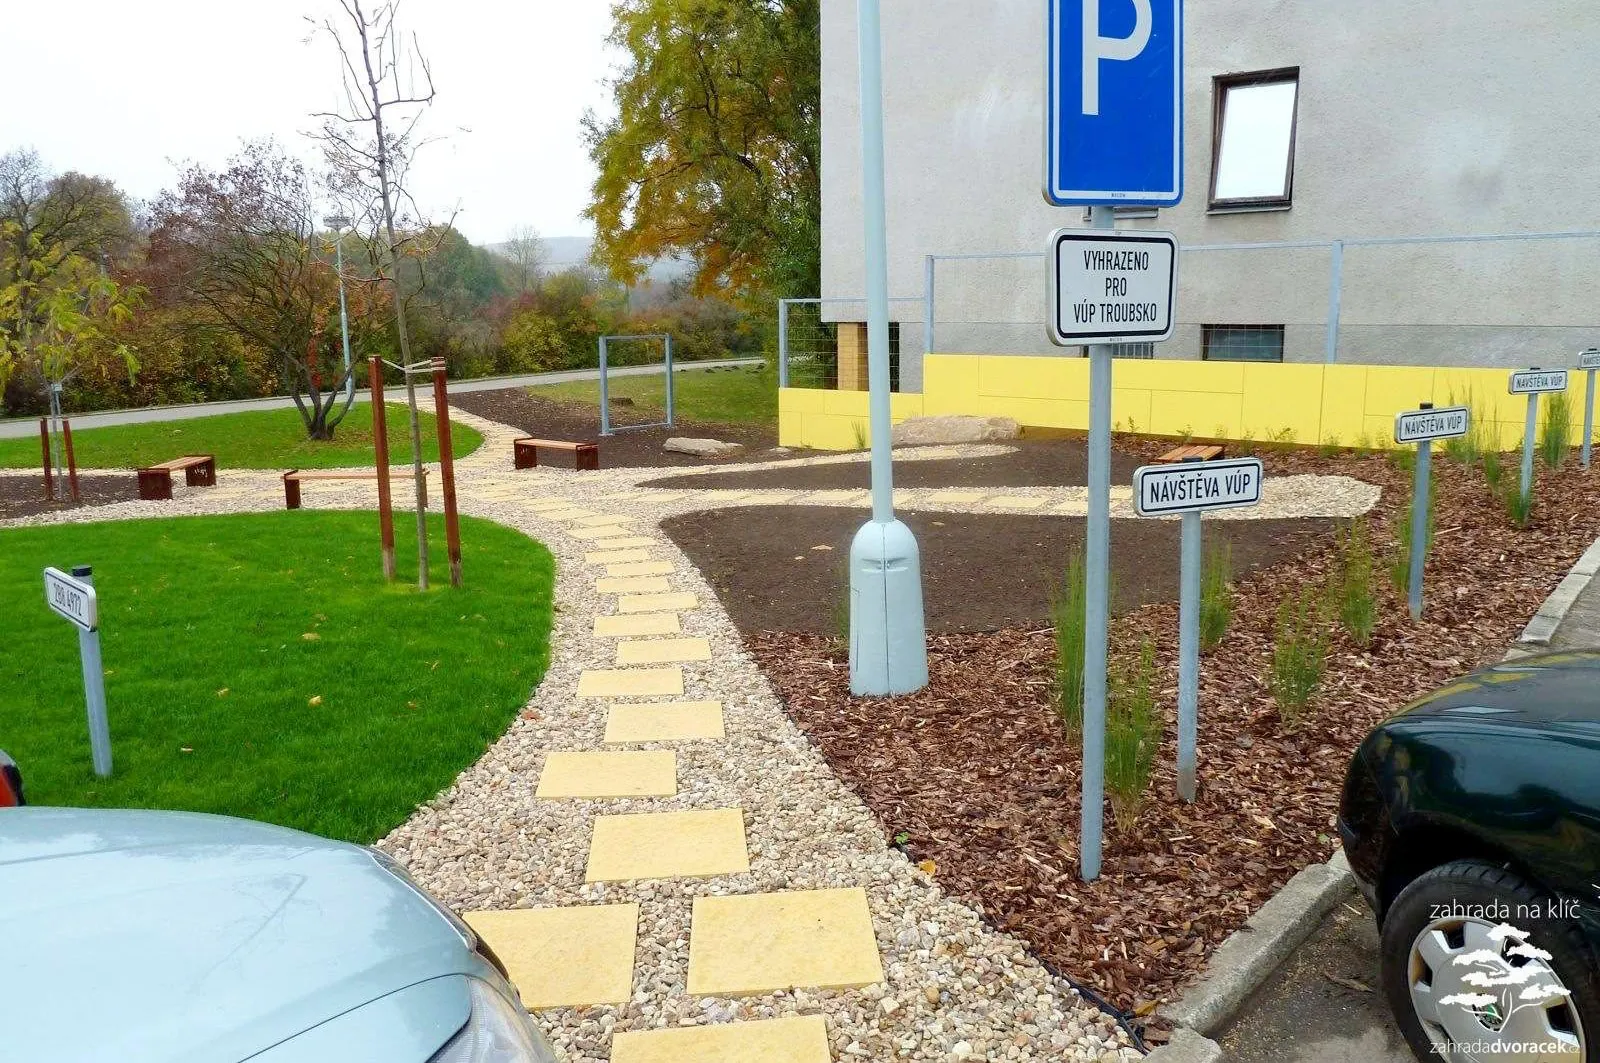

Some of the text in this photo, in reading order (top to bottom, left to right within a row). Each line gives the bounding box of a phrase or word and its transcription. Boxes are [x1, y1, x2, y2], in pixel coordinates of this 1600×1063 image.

[1081, 0, 1152, 116] P
[1083, 250, 1149, 271] VYHRAZENO
[1105, 277, 1127, 297] PRO
[1073, 298, 1157, 323] VÚP TROUBSKO
[1405, 412, 1462, 435] NÁVŠTĚVA VÚP
[1150, 469, 1251, 503] NÁVŠTĚVA VÚP
